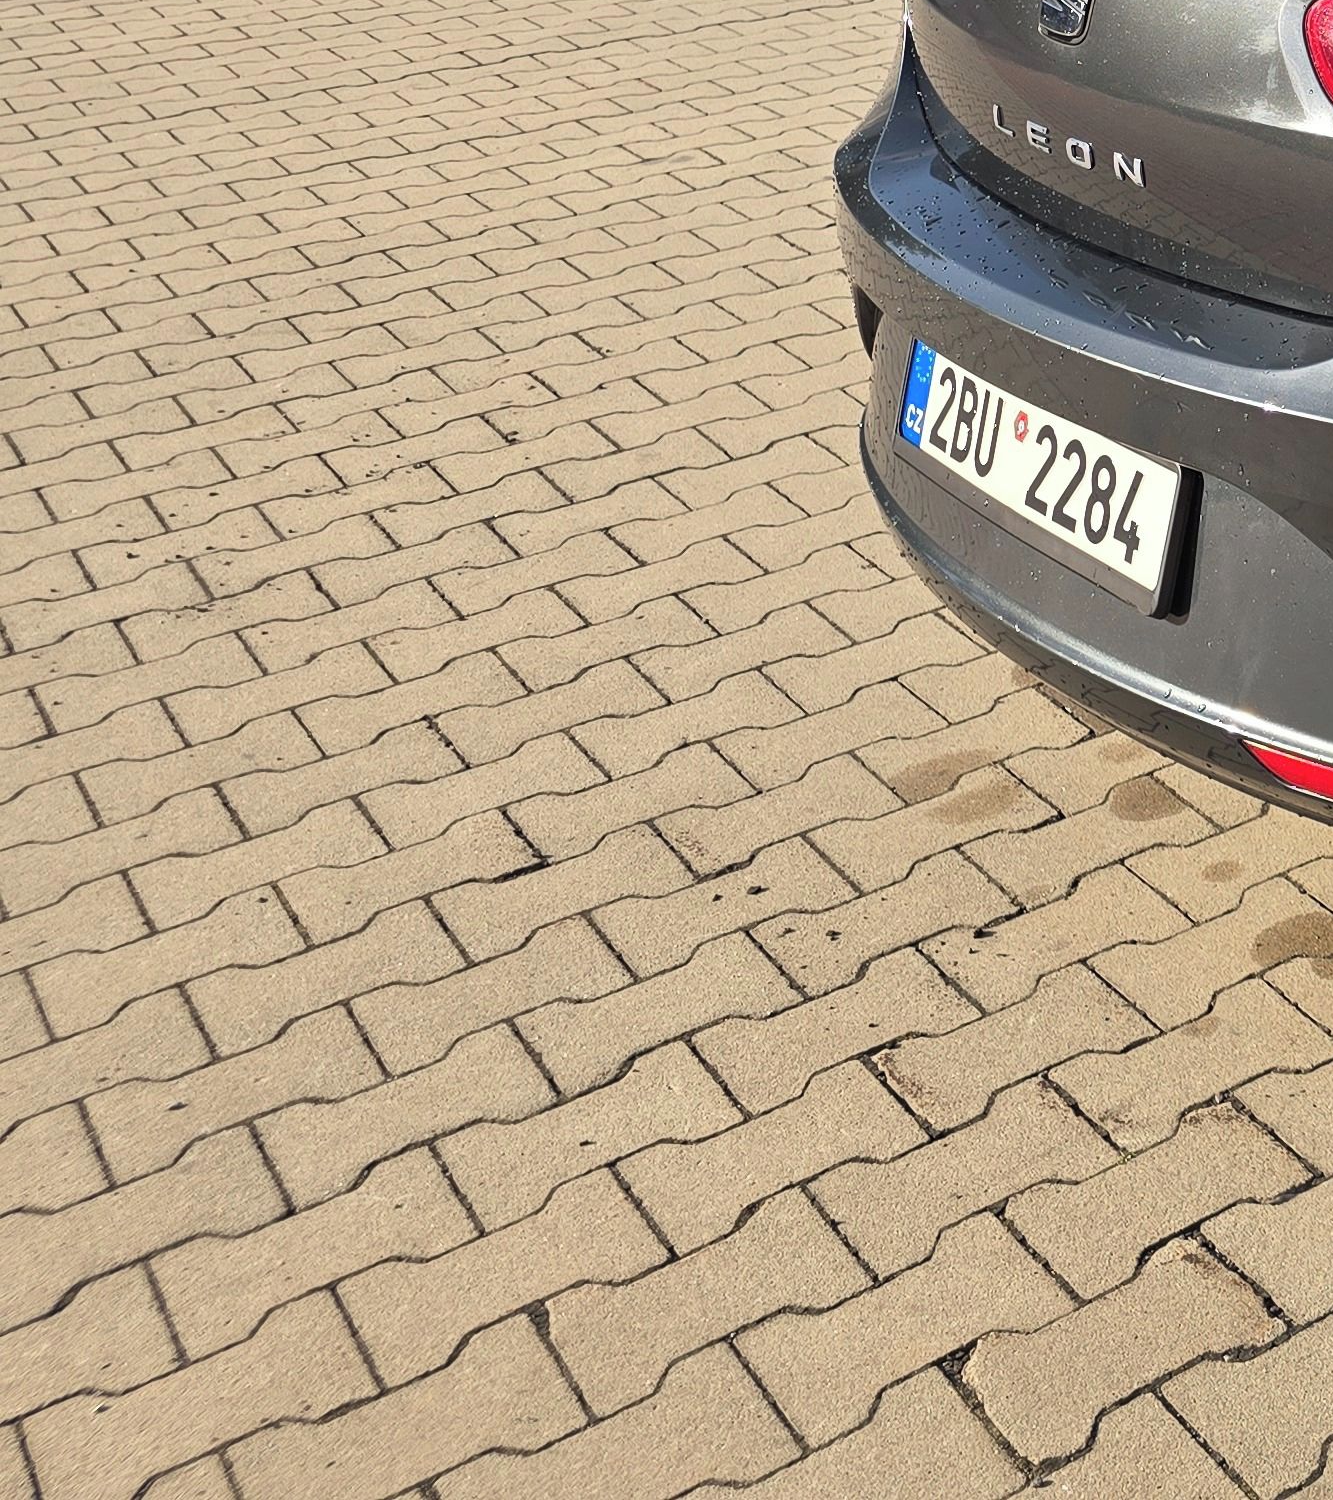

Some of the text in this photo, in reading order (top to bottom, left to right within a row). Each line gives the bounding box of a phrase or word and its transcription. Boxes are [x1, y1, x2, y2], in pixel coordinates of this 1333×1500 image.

[992, 103, 1146, 187] LEON
[905, 403, 924, 434] CZ
[929, 367, 1144, 564] 2BU 2284
